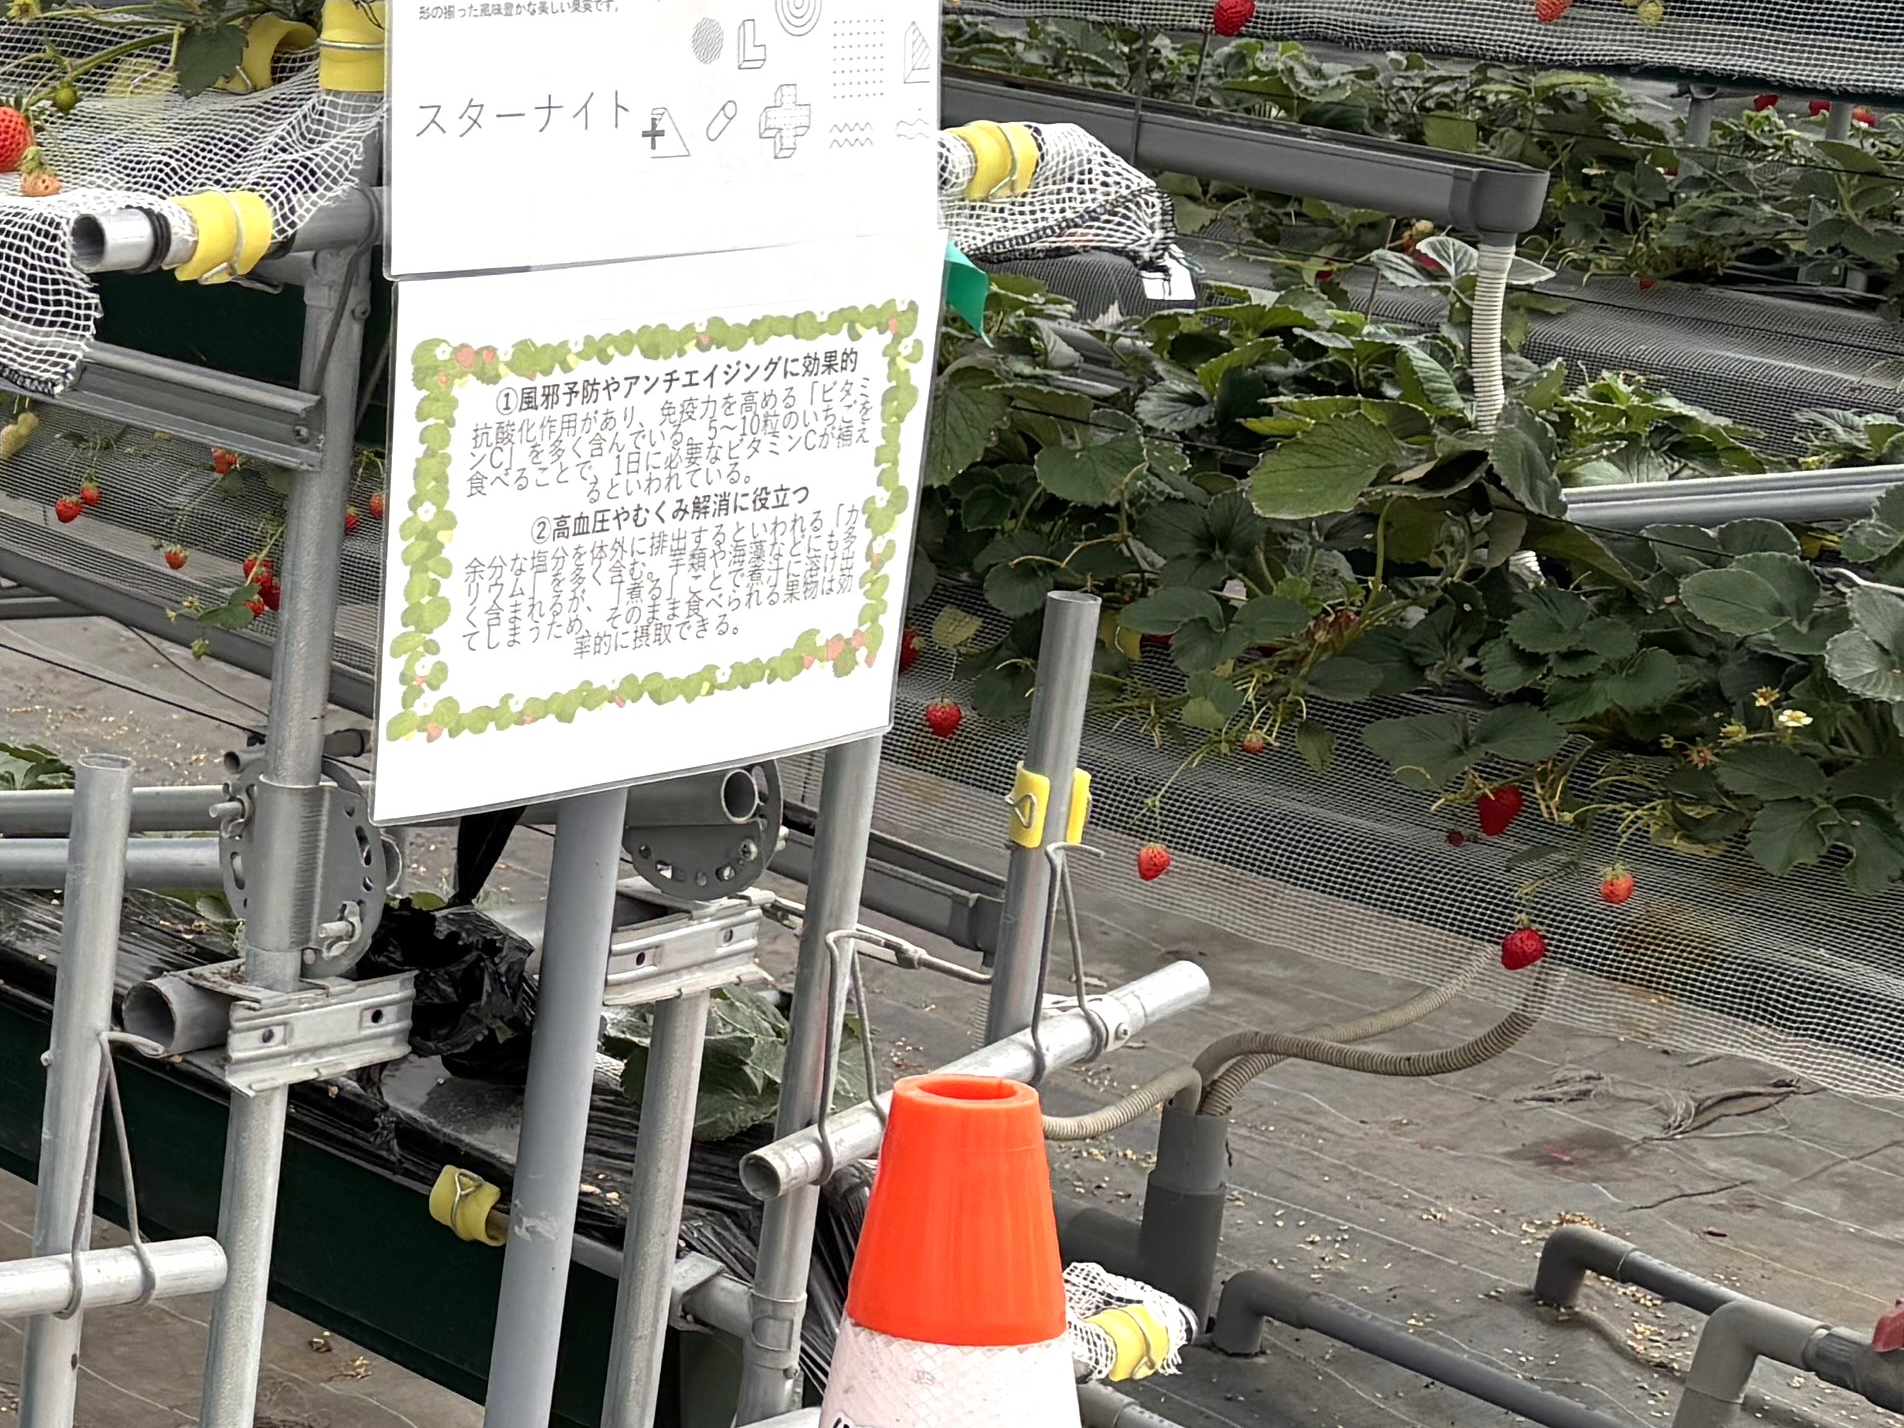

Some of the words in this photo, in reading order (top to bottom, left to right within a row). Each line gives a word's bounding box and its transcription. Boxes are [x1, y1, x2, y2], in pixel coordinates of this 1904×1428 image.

[416, 89, 630, 138] スターナイト
[496, 347, 859, 416] ①風邪予防やアンチエイジングに効果的
[472, 377, 871, 450] 抗酸化作用があり、免疫力を高める「ビタミ
[530, 483, 810, 545] ②高血圧やむくみ解消に役立つ
[586, 463, 751, 504] るといわれている。
[464, 504, 860, 583] 余分な塩分を体外に排出するといわれる「カ
[573, 615, 739, 660] 率的に摂取できる。
